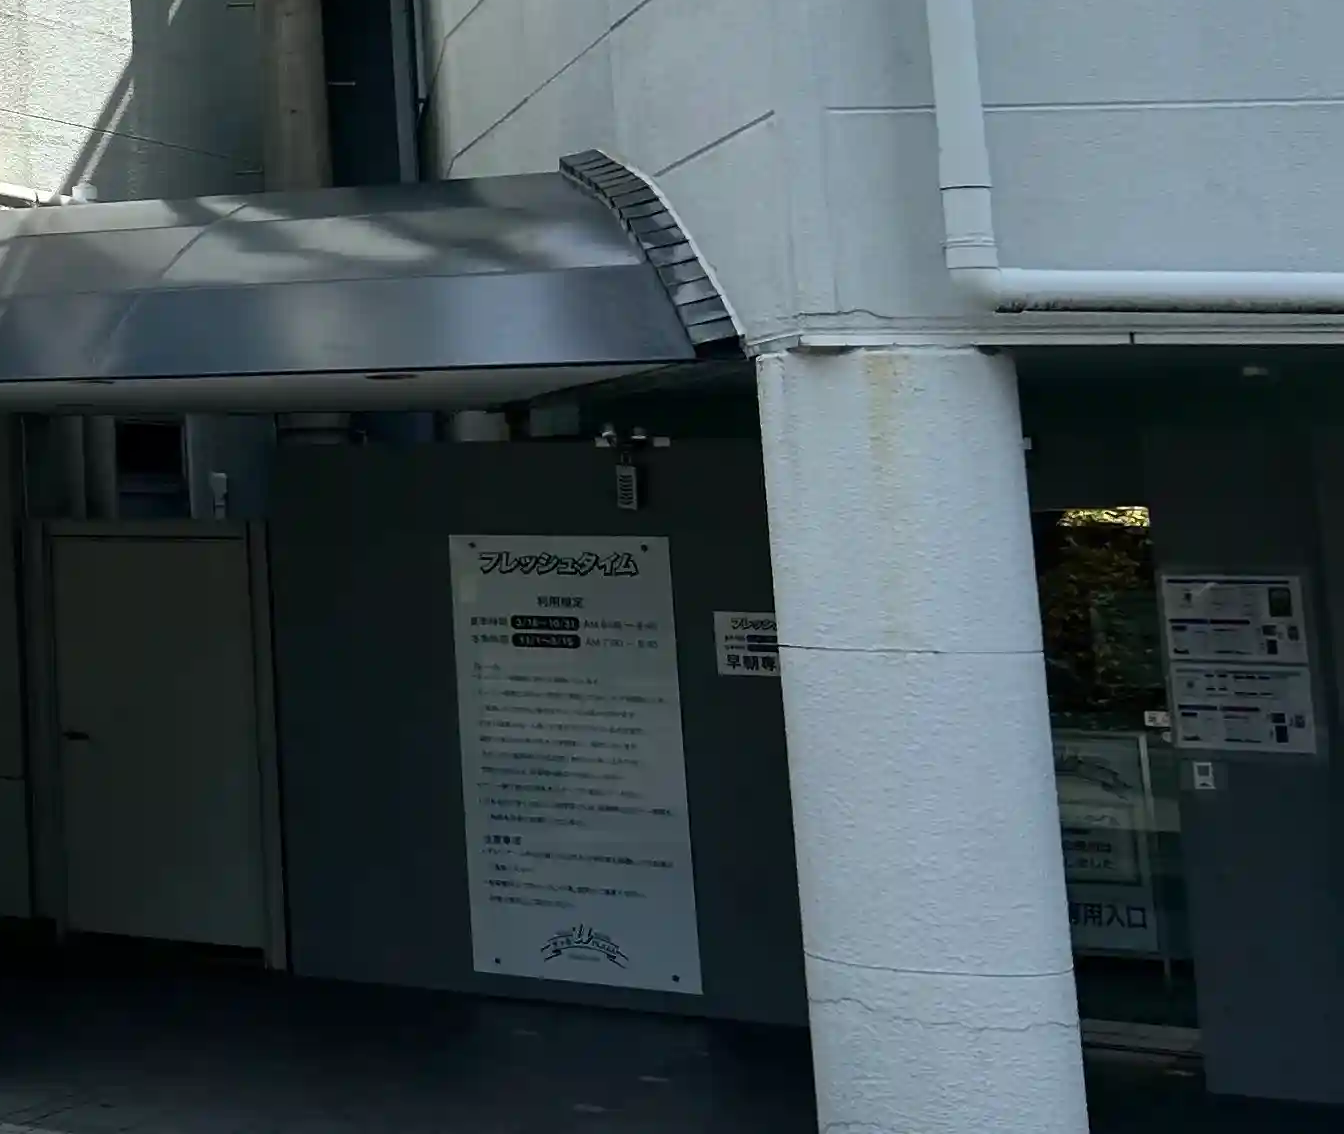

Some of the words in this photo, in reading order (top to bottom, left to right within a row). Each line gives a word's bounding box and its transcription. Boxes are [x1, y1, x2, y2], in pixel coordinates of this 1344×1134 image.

[478, 551, 640, 576] フレッシュタイム
